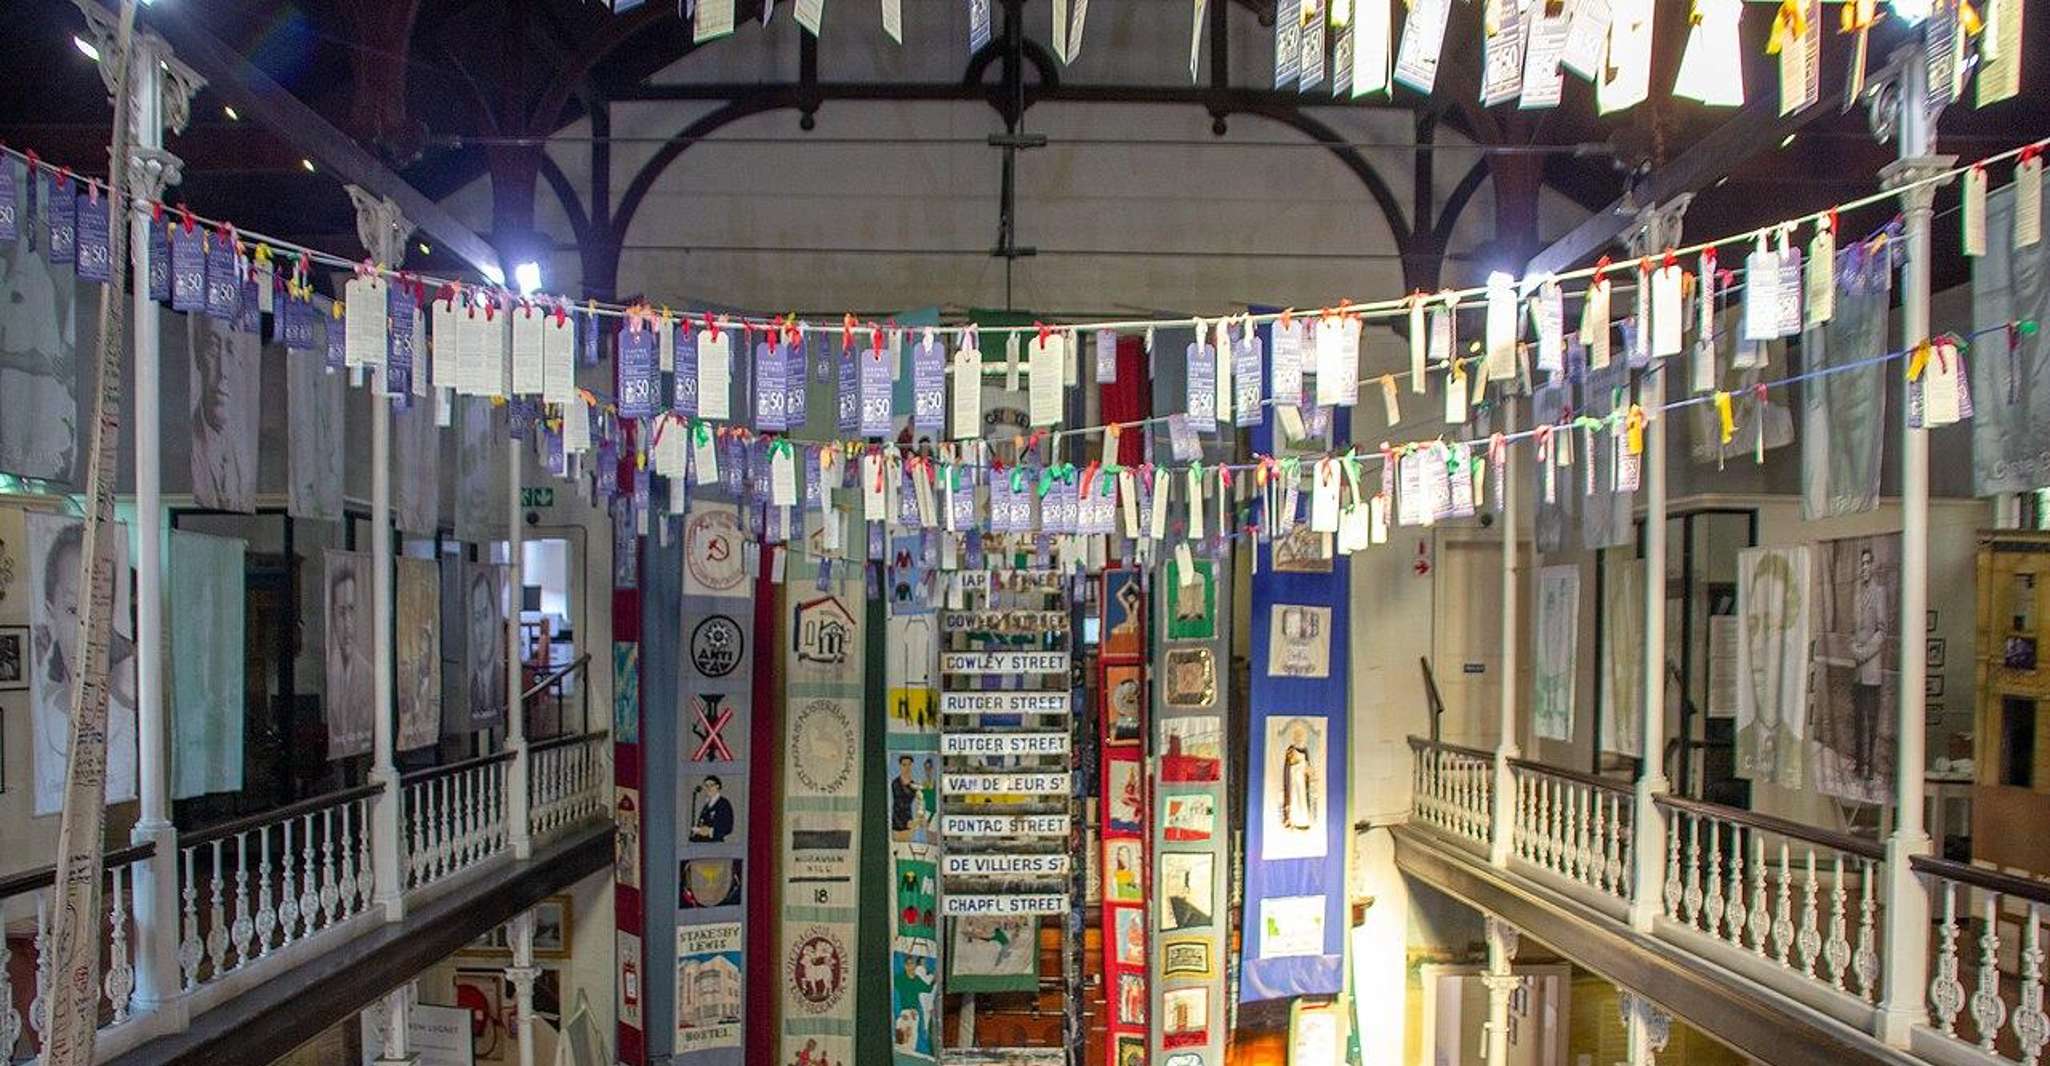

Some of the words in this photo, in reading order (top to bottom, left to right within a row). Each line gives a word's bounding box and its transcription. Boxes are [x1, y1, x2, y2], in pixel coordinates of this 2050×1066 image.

[636, 379, 649, 397] 50
[770, 391, 784, 410] 50
[875, 398, 890, 416] 50
[928, 391, 942, 409] 50
[698, 648, 732, 660] ANTI
[945, 656, 1004, 669] COWLEY
[1012, 656, 1065, 669] STREET
[947, 696, 1003, 710] RUTGER
[1010, 696, 1066, 709] STREET
[948, 738, 1004, 751] RUTGER
[1010, 738, 1066, 750] STREET
[982, 778, 1000, 790] DE
[1007, 778, 1046, 790] LEUR
[948, 819, 1003, 832] PONTAC
[1009, 819, 1066, 832] STREET
[950, 859, 970, 871] DE
[975, 858, 1042, 871] VILLIERS
[814, 889, 829, 904] 18
[1009, 898, 1064, 912] STREET
